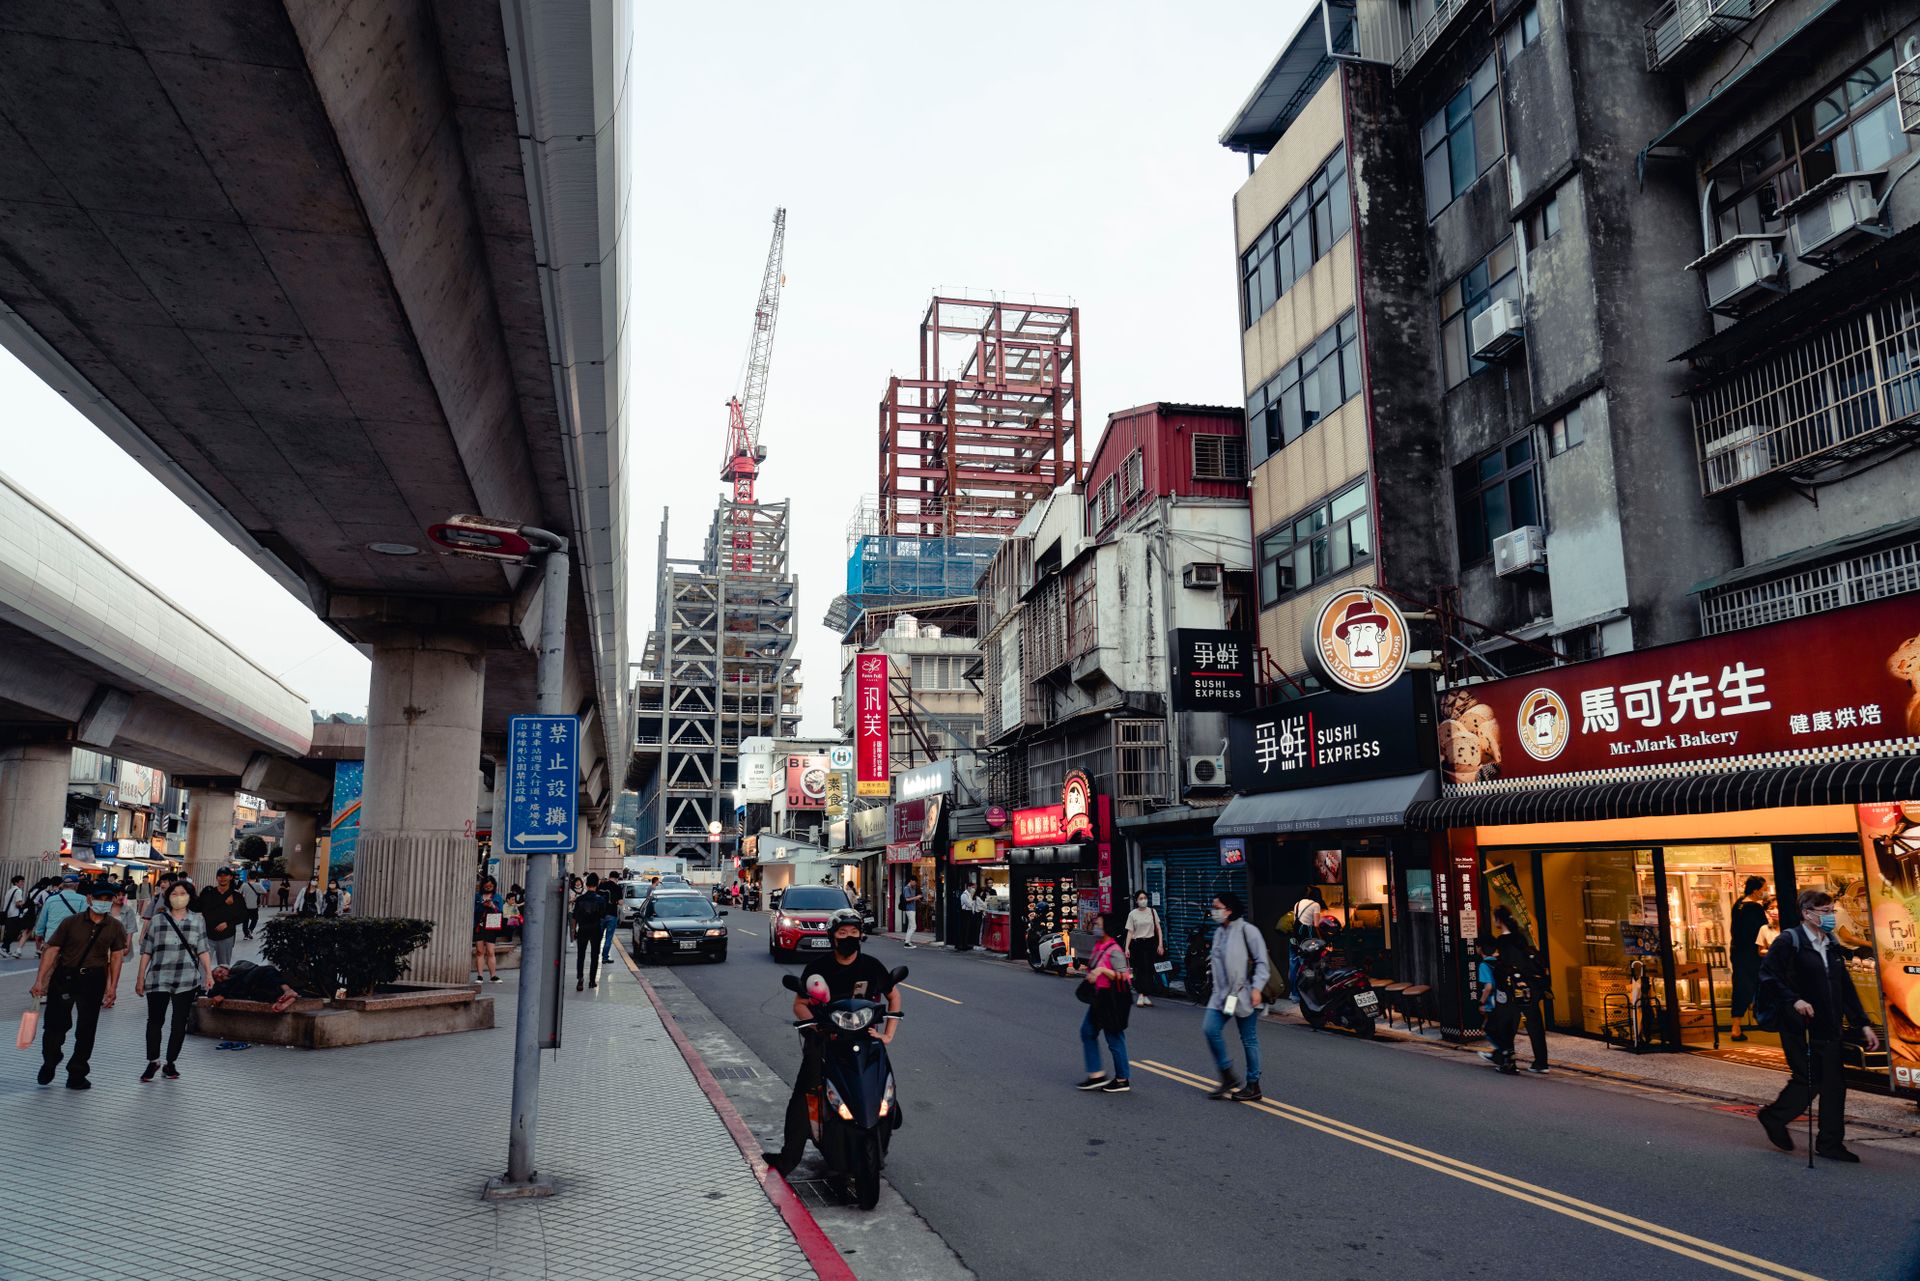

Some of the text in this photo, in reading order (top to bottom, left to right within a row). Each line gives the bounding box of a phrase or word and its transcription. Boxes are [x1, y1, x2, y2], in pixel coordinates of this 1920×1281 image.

[1193, 642, 1240, 670] 爭鮮
[1322, 635, 1402, 682] Mr. Mark since 1998
[1194, 679, 1226, 689] SUSHI
[1195, 689, 1242, 699] EXPRESS
[864, 687, 881, 736] 汎芙
[1580, 661, 1772, 735] 馬可先生
[1789, 703, 1882, 735] 健康烘焙
[1255, 715, 1307, 774] 爭鮮
[1317, 723, 1358, 745] SUSHI
[1609, 730, 1739, 756] Mr.Mark Bakery
[1318, 740, 1381, 765] EXPRESS
[545, 722, 568, 827] 禁止設攤
[828, 777, 842, 807] 素食
[1276, 820, 1321, 831] SUSHI EXPRESS
[1345, 814, 1398, 826] SUSHI EXPRESS
[1888, 919, 1916, 941] Full
